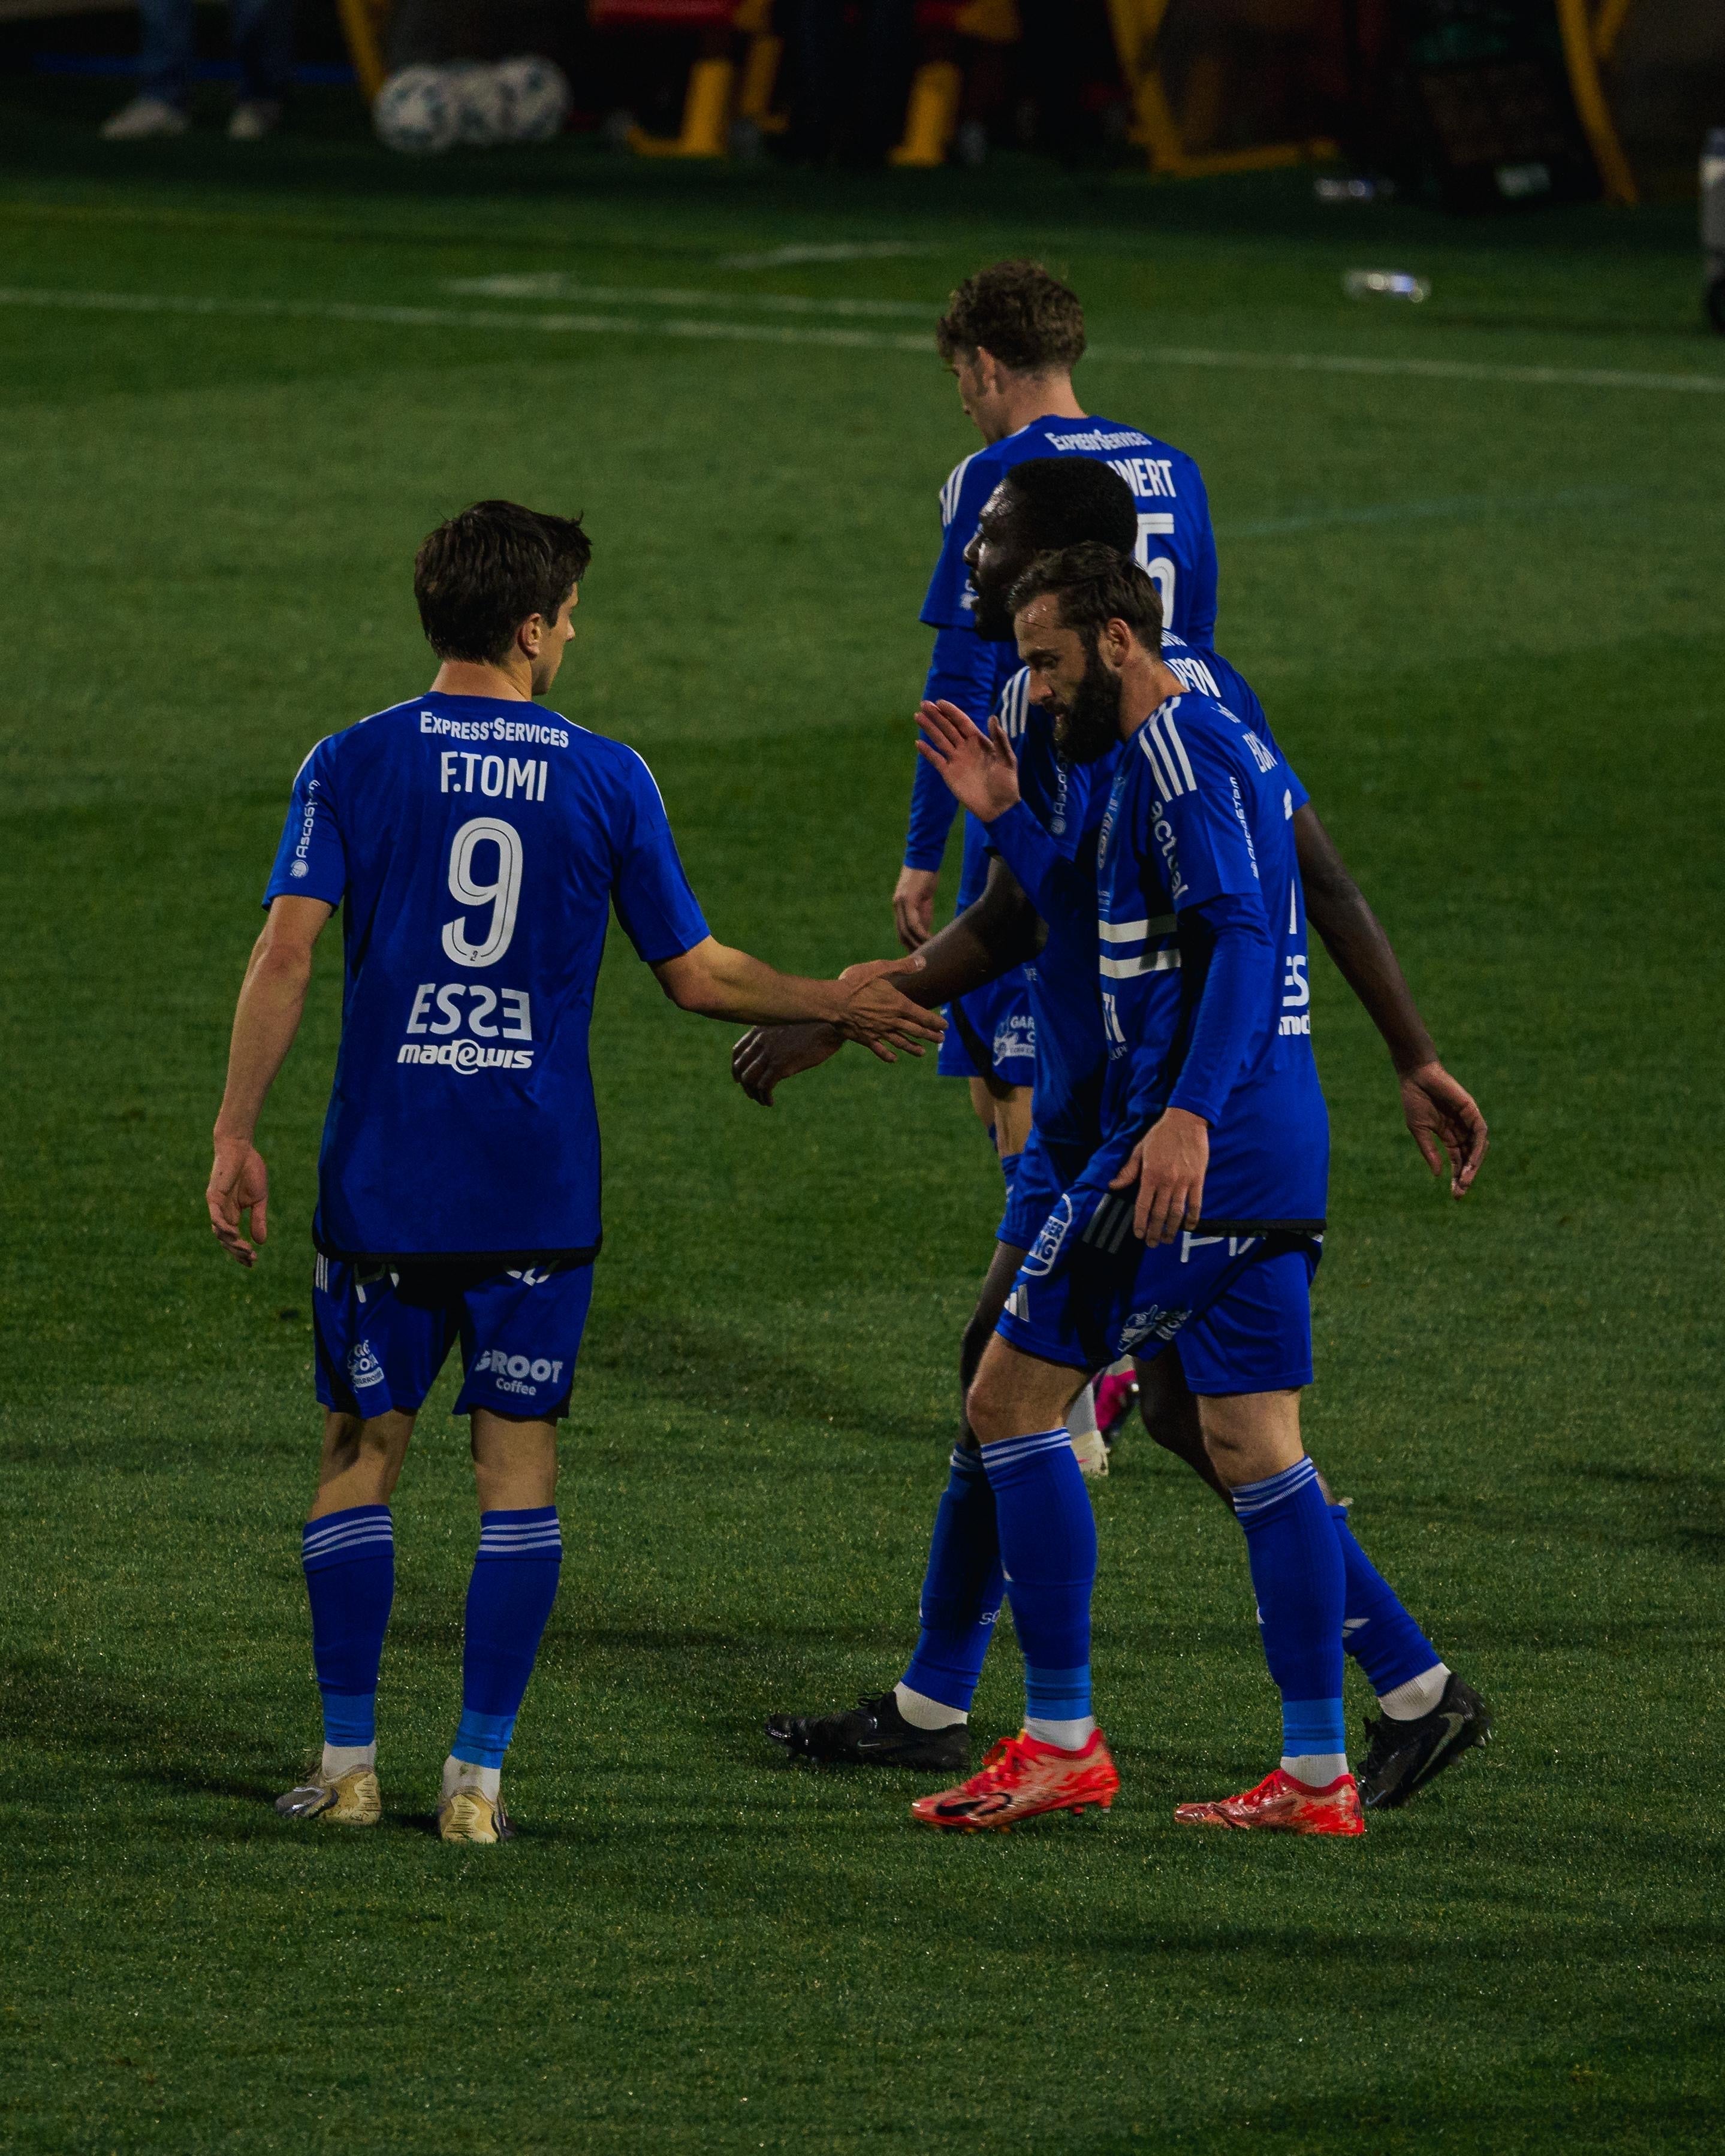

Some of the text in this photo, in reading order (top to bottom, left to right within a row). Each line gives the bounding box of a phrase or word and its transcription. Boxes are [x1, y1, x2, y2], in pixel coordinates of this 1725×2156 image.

[441, 751, 548, 802] F.TOMI
[442, 817, 523, 968] 9
[496, 1378, 537, 1396] Coffee
